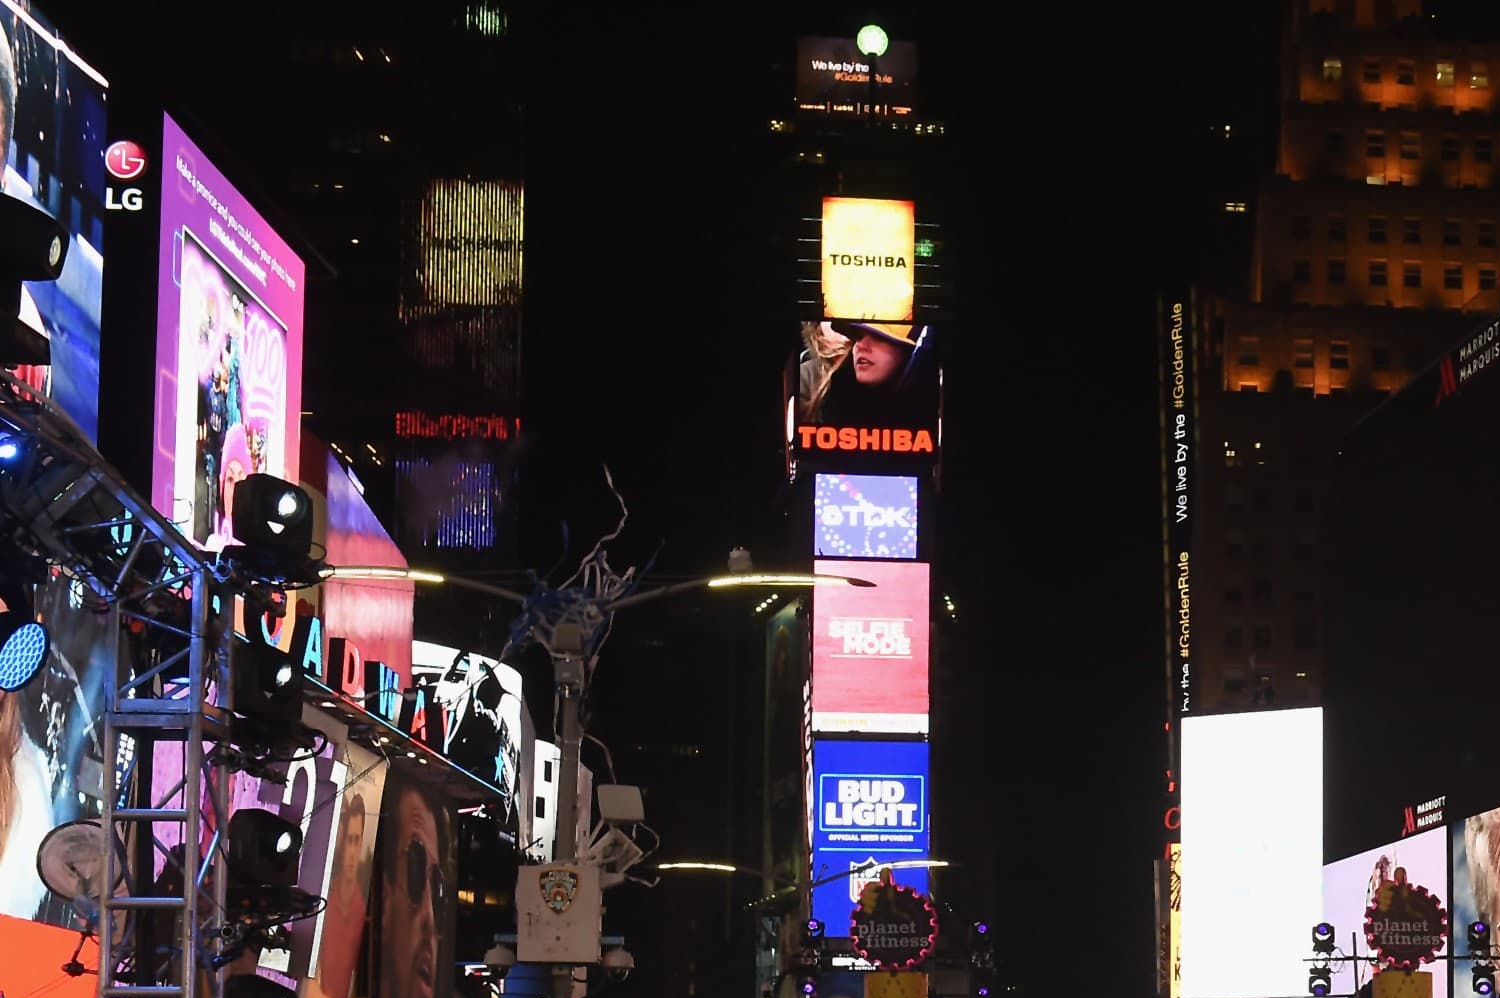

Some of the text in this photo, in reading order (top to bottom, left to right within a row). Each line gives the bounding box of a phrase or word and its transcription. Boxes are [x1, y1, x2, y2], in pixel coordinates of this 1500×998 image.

[105, 187, 143, 211] LG
[829, 253, 907, 268] TOSHIBA
[1460, 342, 1500, 383] MARQUIS
[1170, 303, 1189, 522] We live by the #GoldenRule
[798, 426, 933, 452] TOSHIBA
[838, 779, 905, 804] BUD
[857, 920, 916, 937] planet
[1373, 918, 1429, 935] planet
[865, 934, 929, 948] fitness
[1381, 932, 1440, 945] fitness
